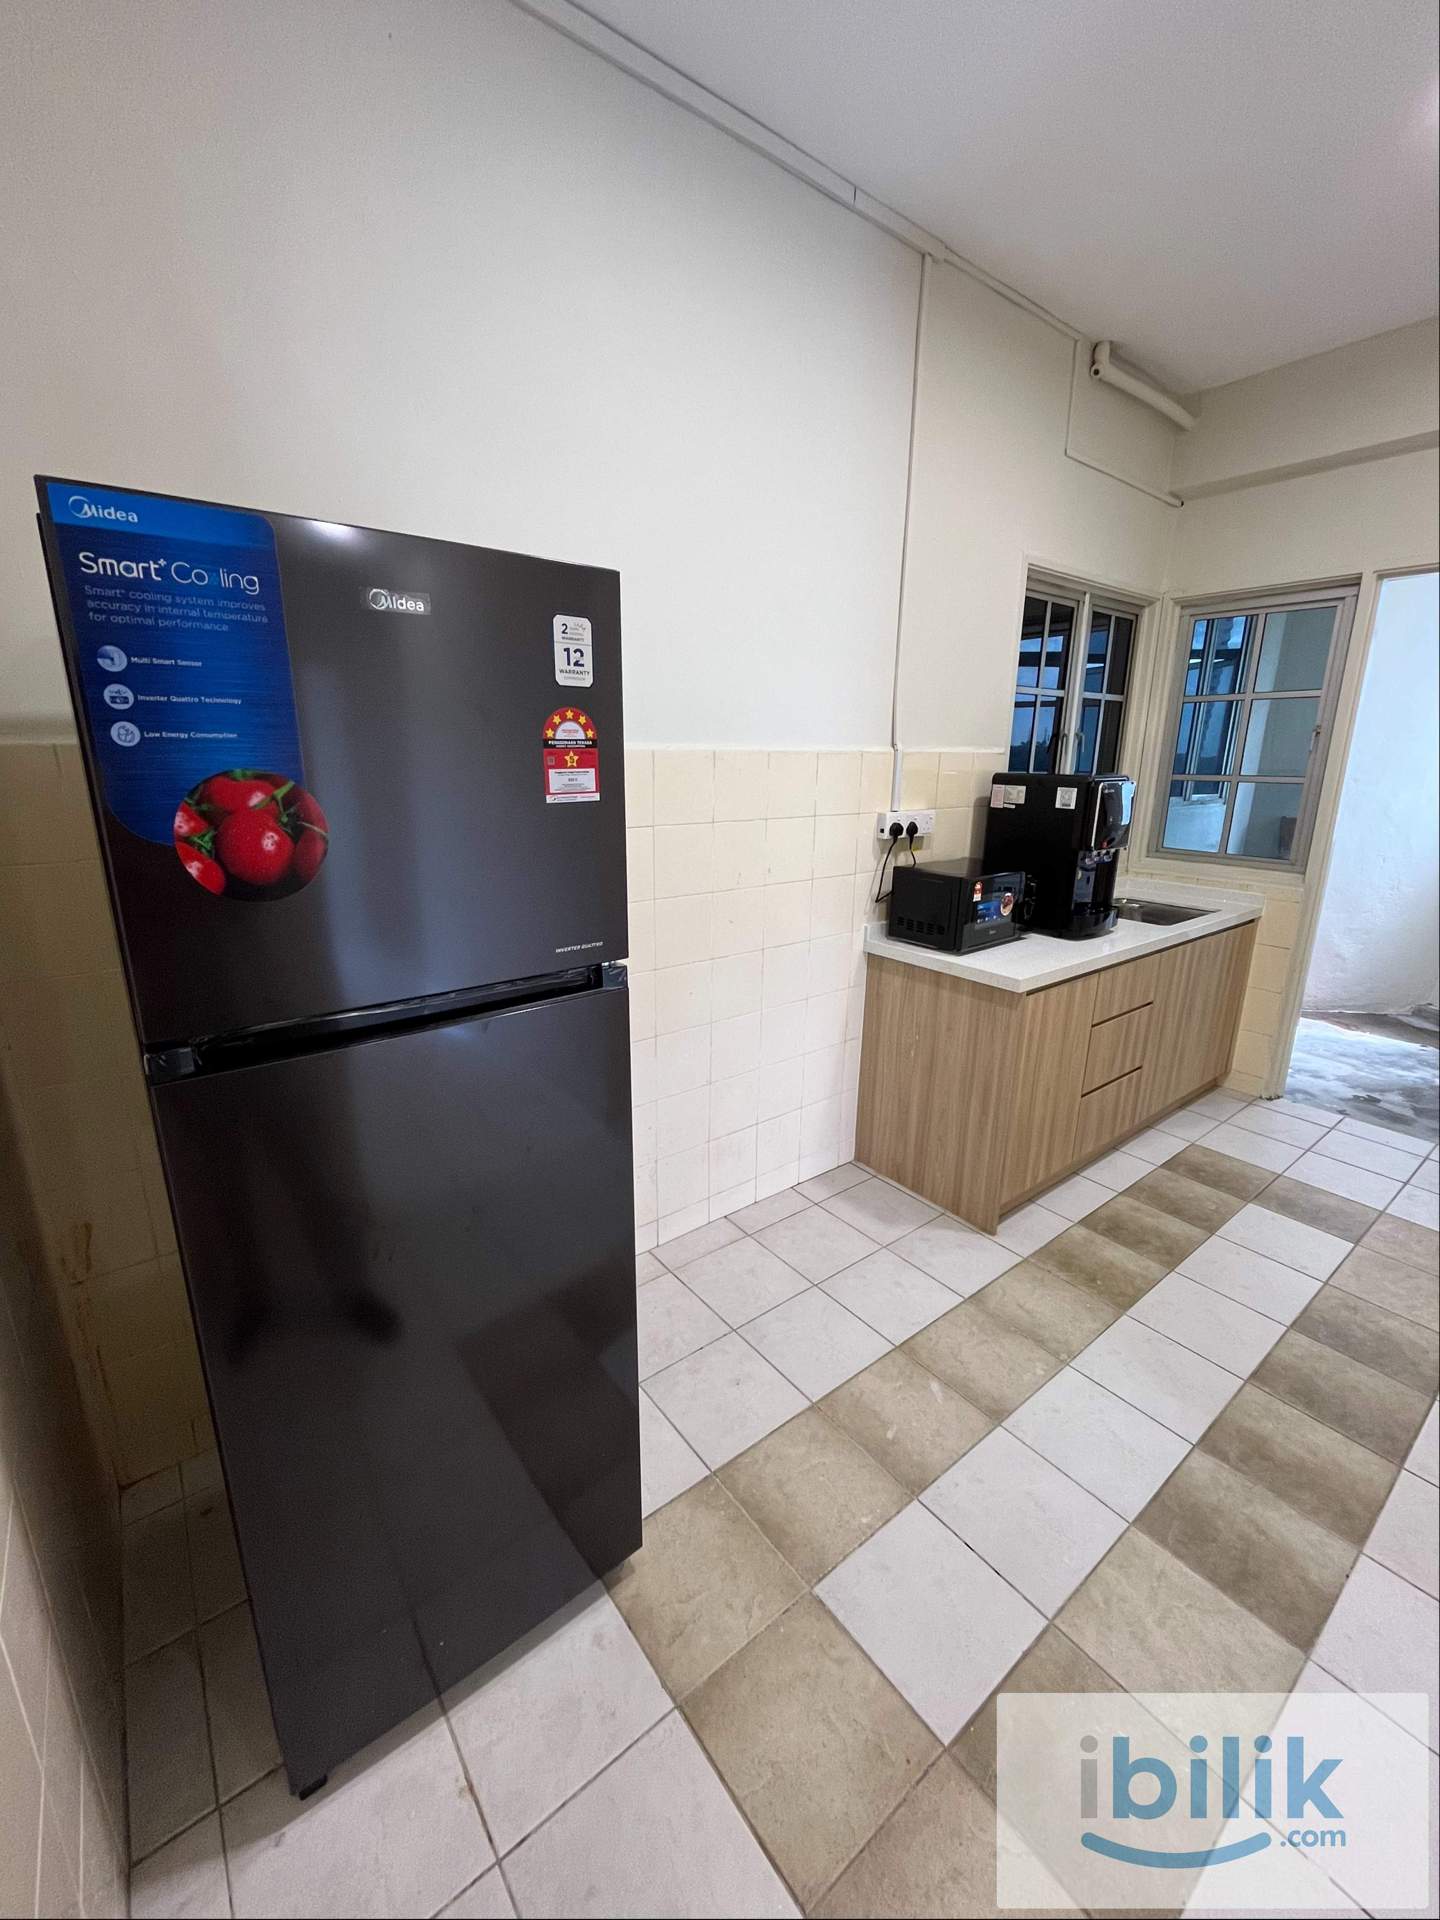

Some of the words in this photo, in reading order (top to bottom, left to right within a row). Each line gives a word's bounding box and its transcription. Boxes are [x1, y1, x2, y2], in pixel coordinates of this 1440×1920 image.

[68, 495, 139, 523] Midea
[171, 562, 260, 595] Coling
[129, 590, 172, 603] cooling
[175, 595, 214, 607] system
[217, 599, 266, 611] improves
[369, 588, 425, 612] Midea
[87, 600, 141, 613] accuracy
[144, 604, 156, 612] in
[158, 606, 201, 617] internal
[203, 609, 268, 623] temperature
[88, 611, 106, 622] for
[110, 615, 155, 627] optimal
[561, 623, 568, 635] 2
[131, 656, 150, 664] Multi
[177, 659, 202, 667] Sensor
[563, 647, 585, 668] 12
[559, 668, 590, 676] WARRANTY
[137, 694, 168, 702] Inverter
[170, 695, 199, 703] Quattro
[201, 697, 242, 705] Technology
[555, 945, 581, 953] INVERTER
